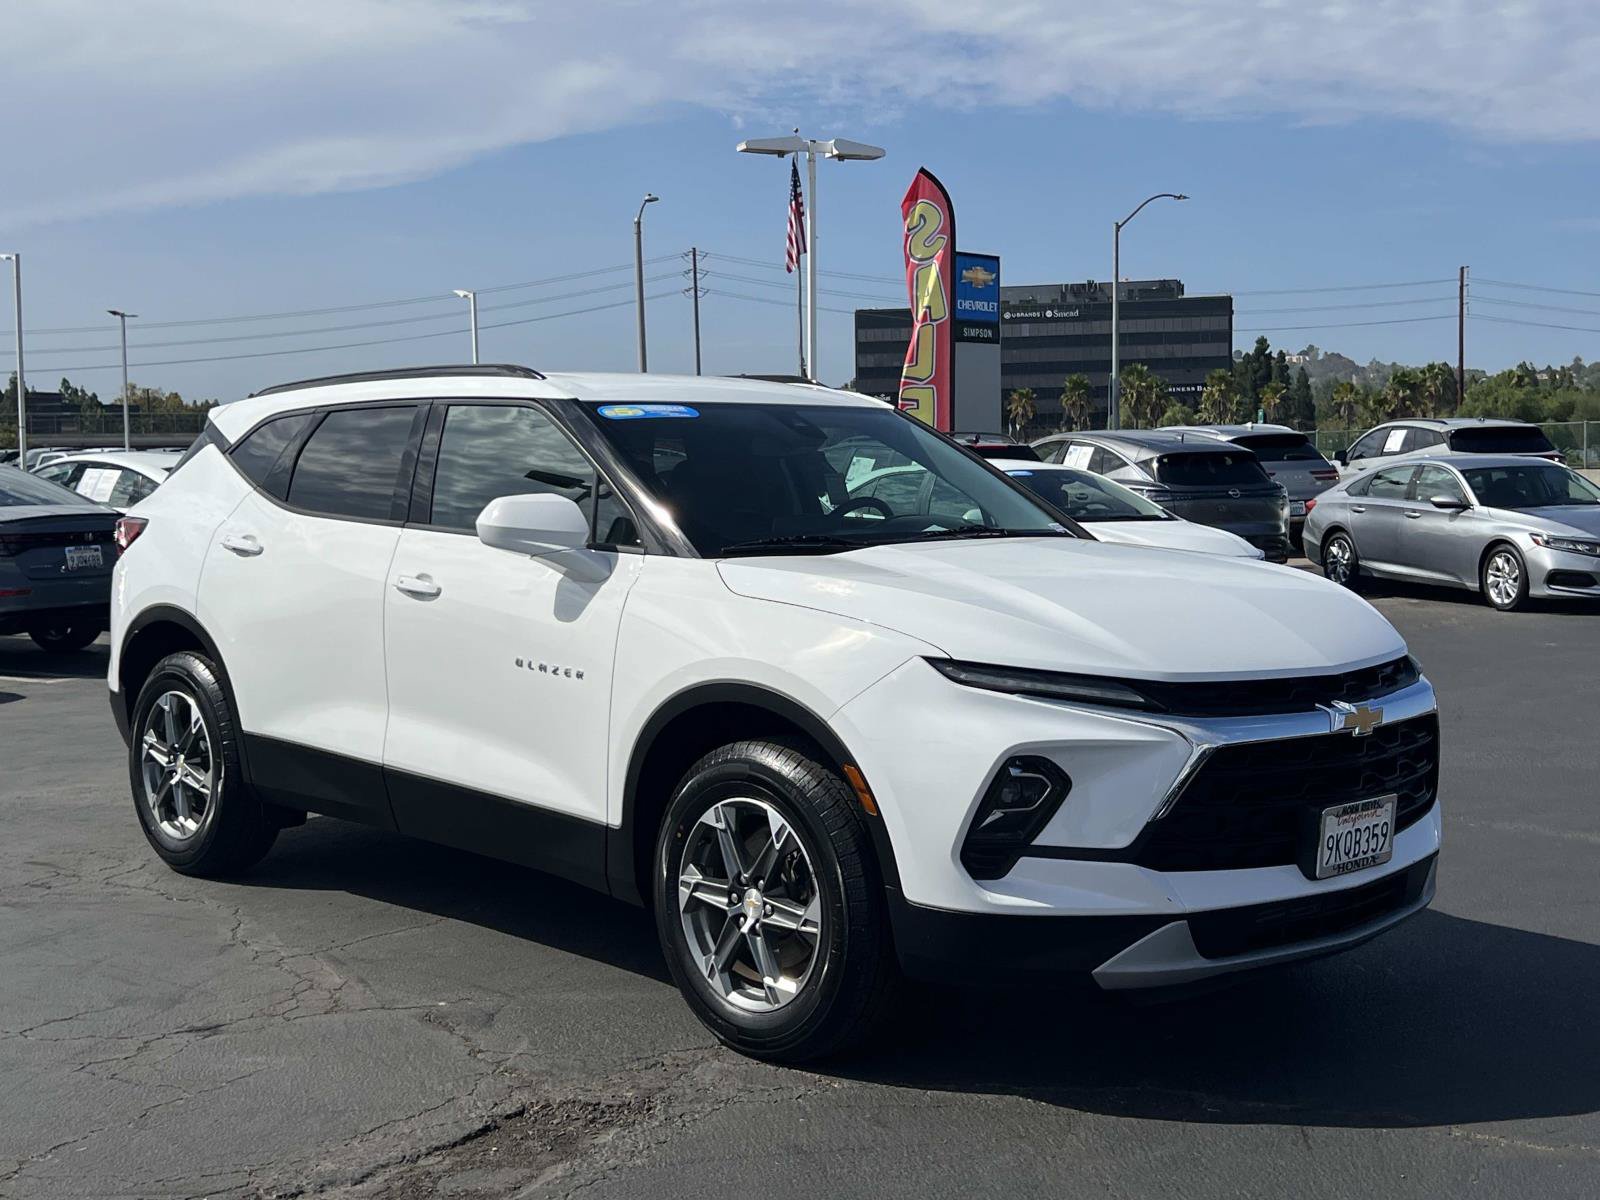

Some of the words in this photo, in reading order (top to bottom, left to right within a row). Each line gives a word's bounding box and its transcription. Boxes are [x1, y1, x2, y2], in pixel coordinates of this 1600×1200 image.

[957, 299, 998, 312] CHEVROLET
[1053, 308, 1079, 318] Smead
[963, 328, 992, 338] SIMPSON
[515, 657, 584, 680] BLAZER
[1325, 821, 1389, 866] 9KQB359
[1337, 855, 1377, 873] HONDA
